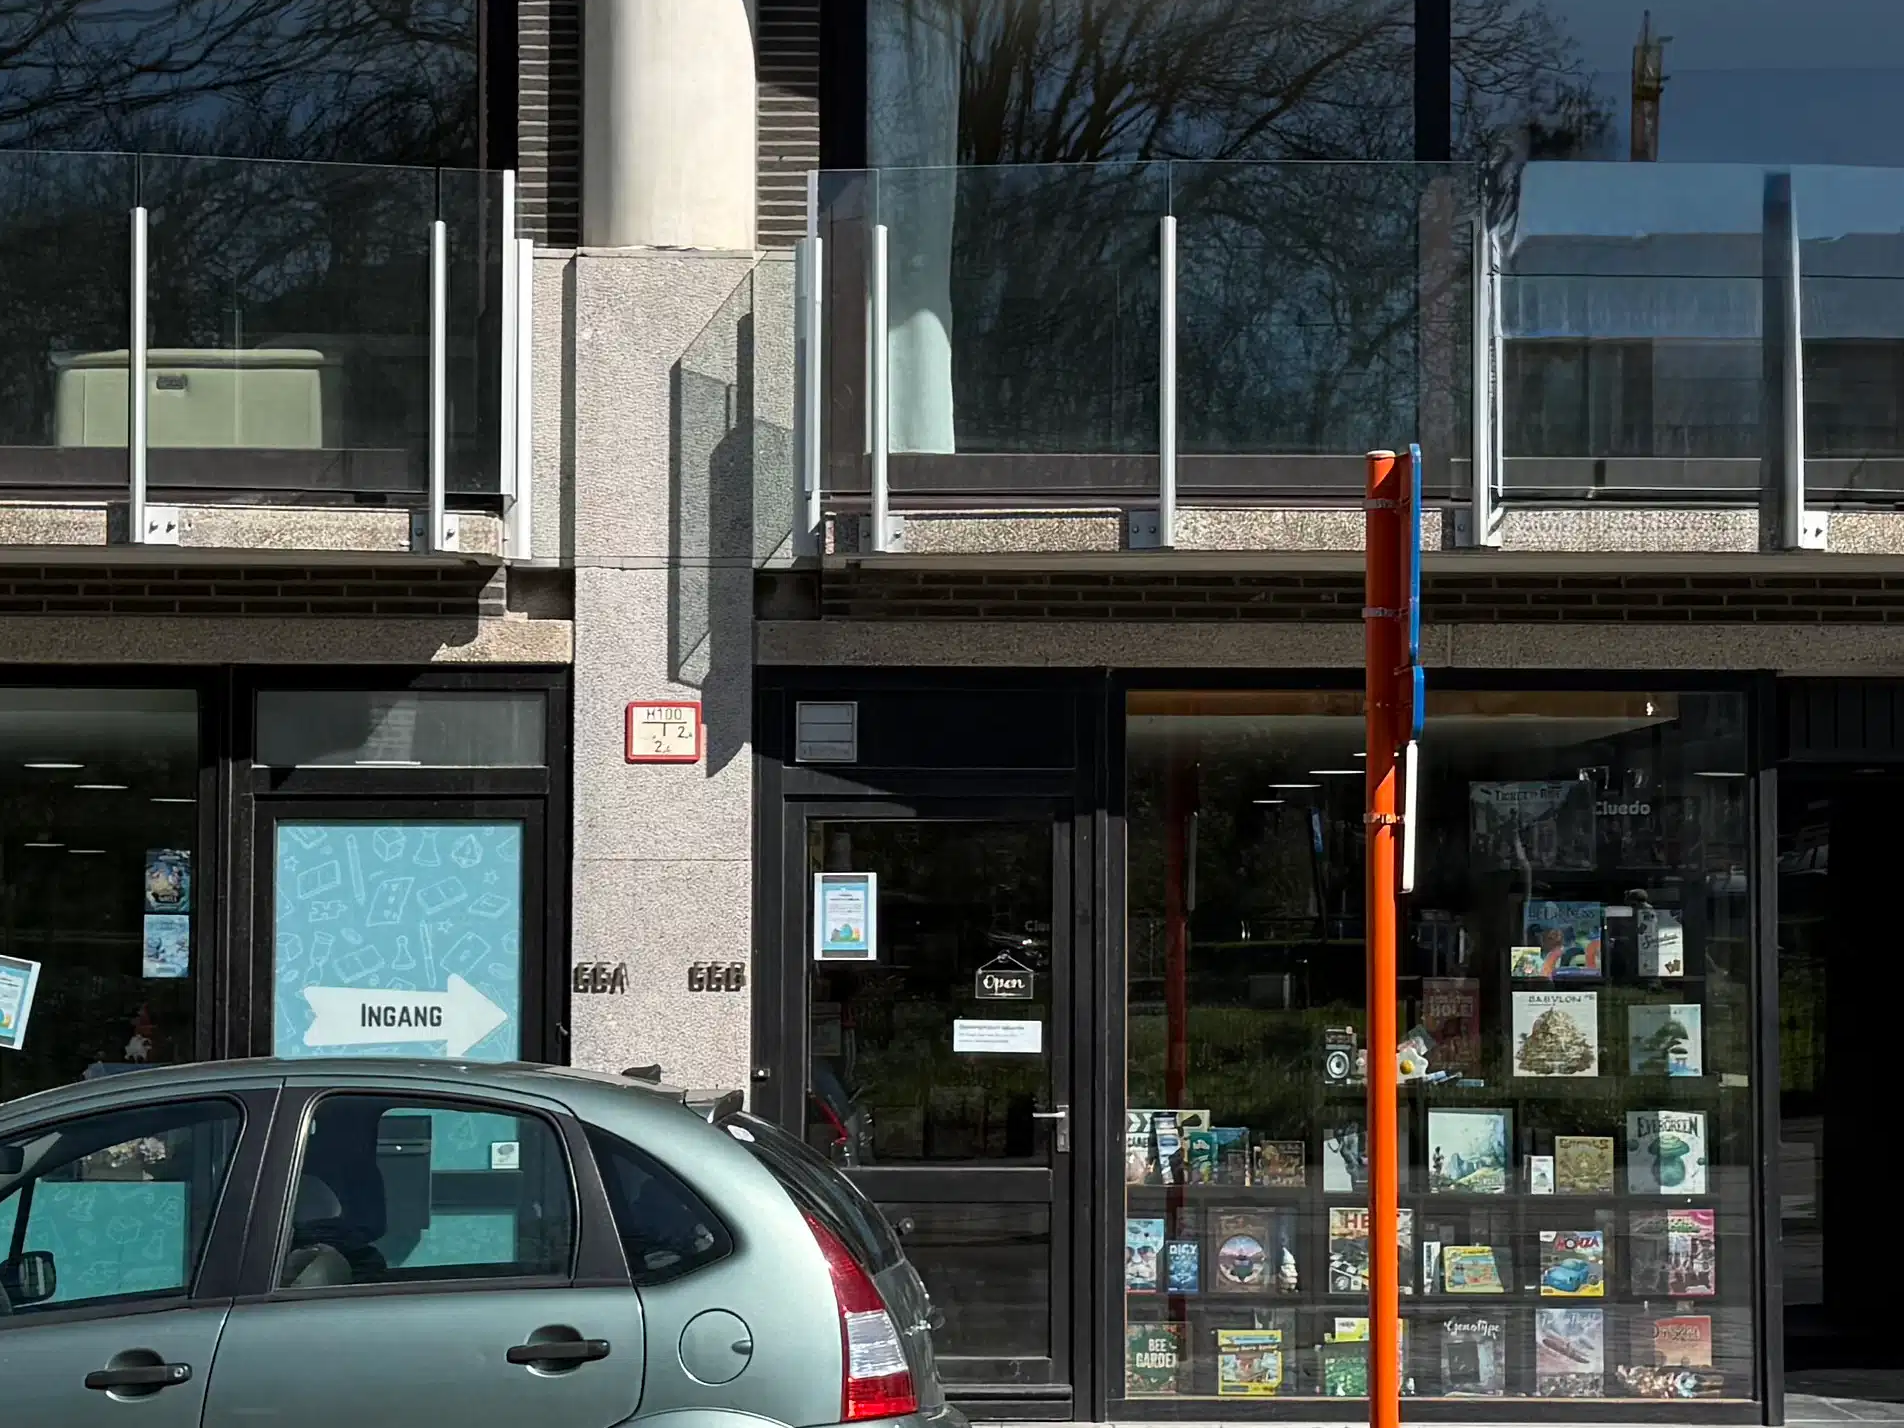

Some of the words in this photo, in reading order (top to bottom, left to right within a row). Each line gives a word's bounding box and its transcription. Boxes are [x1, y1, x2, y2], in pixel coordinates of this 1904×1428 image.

[983, 975, 1025, 995] Open
[360, 1002, 443, 1029] INGANG
[1637, 1115, 1700, 1138] EVERGREEN
[1148, 1338, 1167, 1352] BEE
